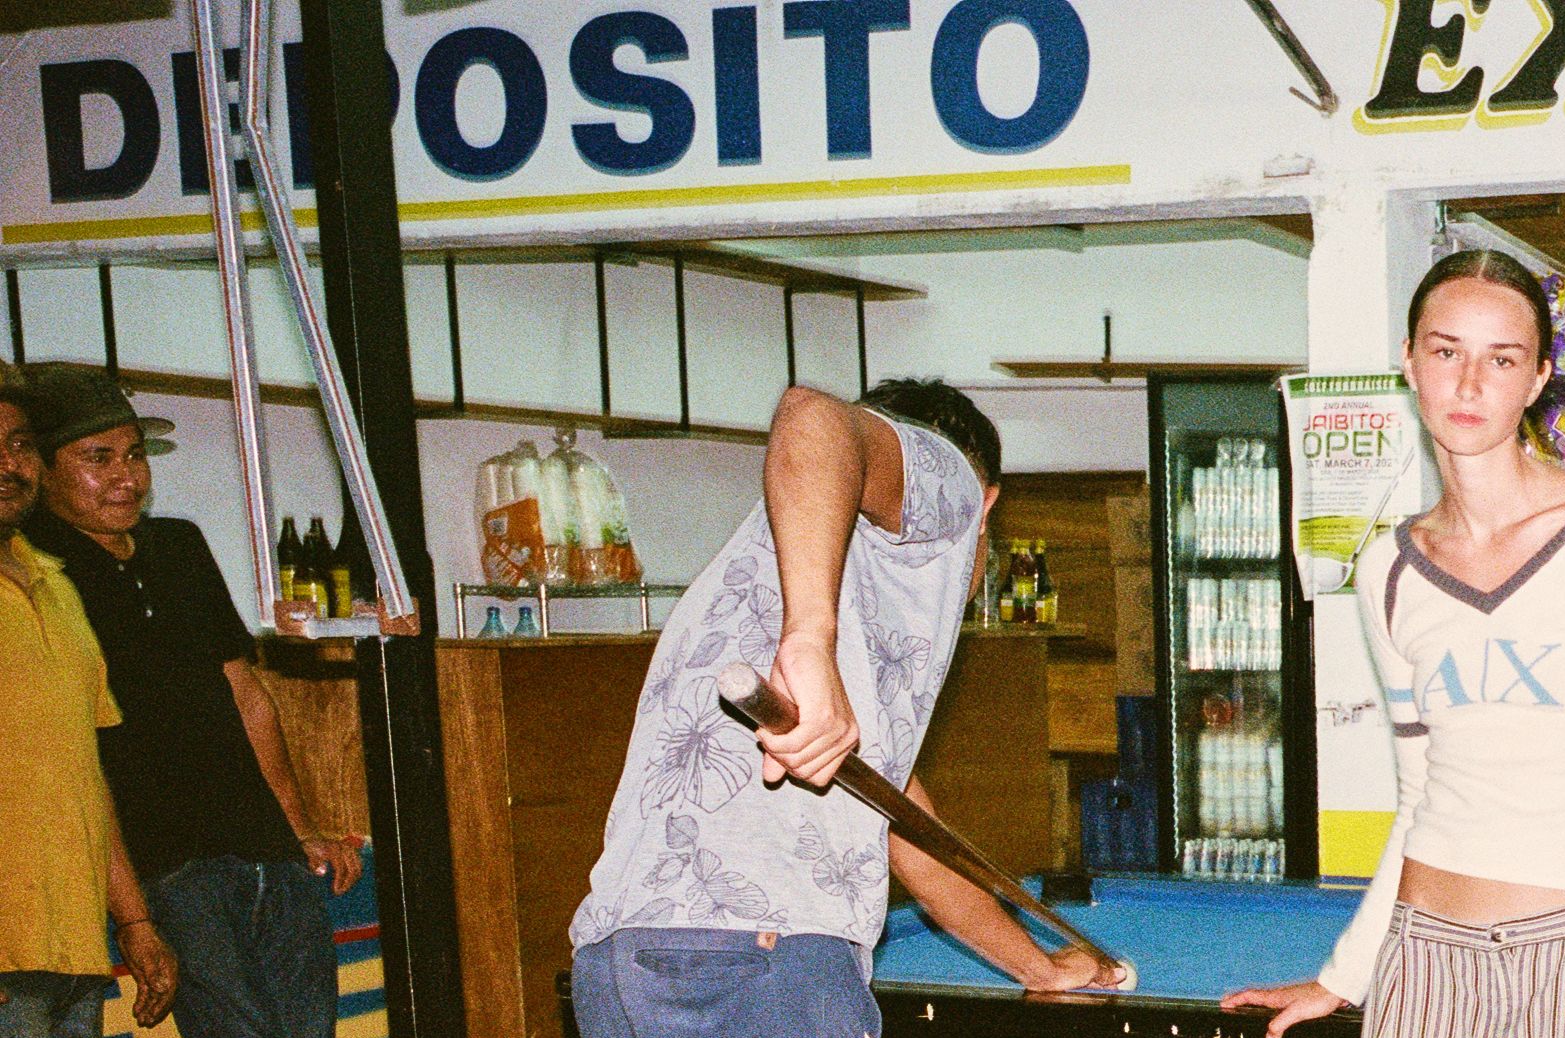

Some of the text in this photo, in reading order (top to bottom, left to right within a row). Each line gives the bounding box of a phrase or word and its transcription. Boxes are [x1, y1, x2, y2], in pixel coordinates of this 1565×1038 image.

[1341, 401, 1374, 409] ANNUAL
[1303, 412, 1401, 431] JAIBITOS
[1303, 430, 1402, 459] OPEN
[1324, 459, 1361, 469] MARCH
[1376, 459, 1399, 468] 202
